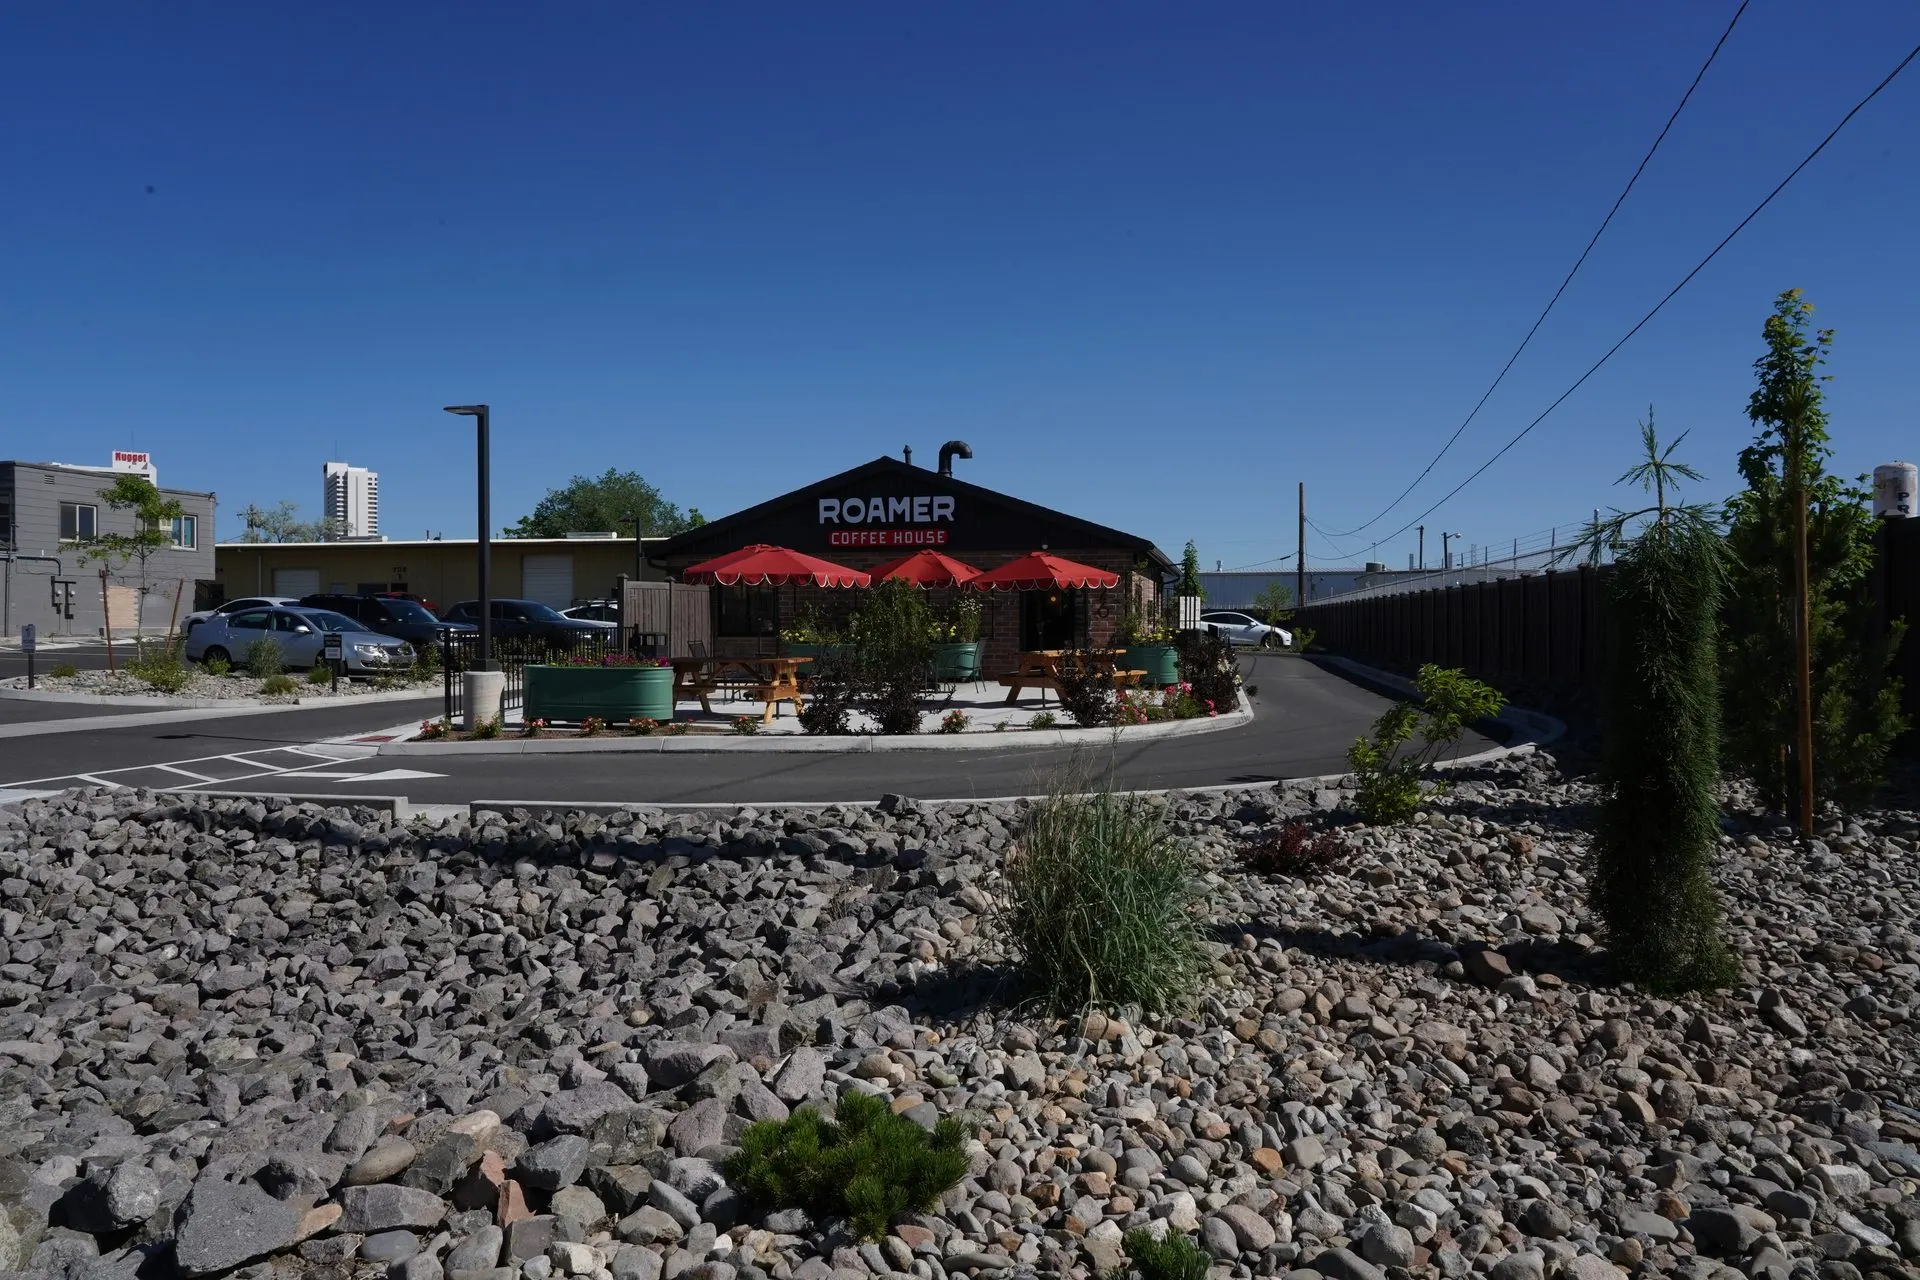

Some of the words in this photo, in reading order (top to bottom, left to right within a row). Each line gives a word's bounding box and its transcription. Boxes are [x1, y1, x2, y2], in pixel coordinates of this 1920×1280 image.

[115, 452, 147, 463] Nugget
[819, 496, 955, 524] ROAMER
[831, 531, 887, 545] COFFEE
[893, 530, 945, 544] HOUSE
